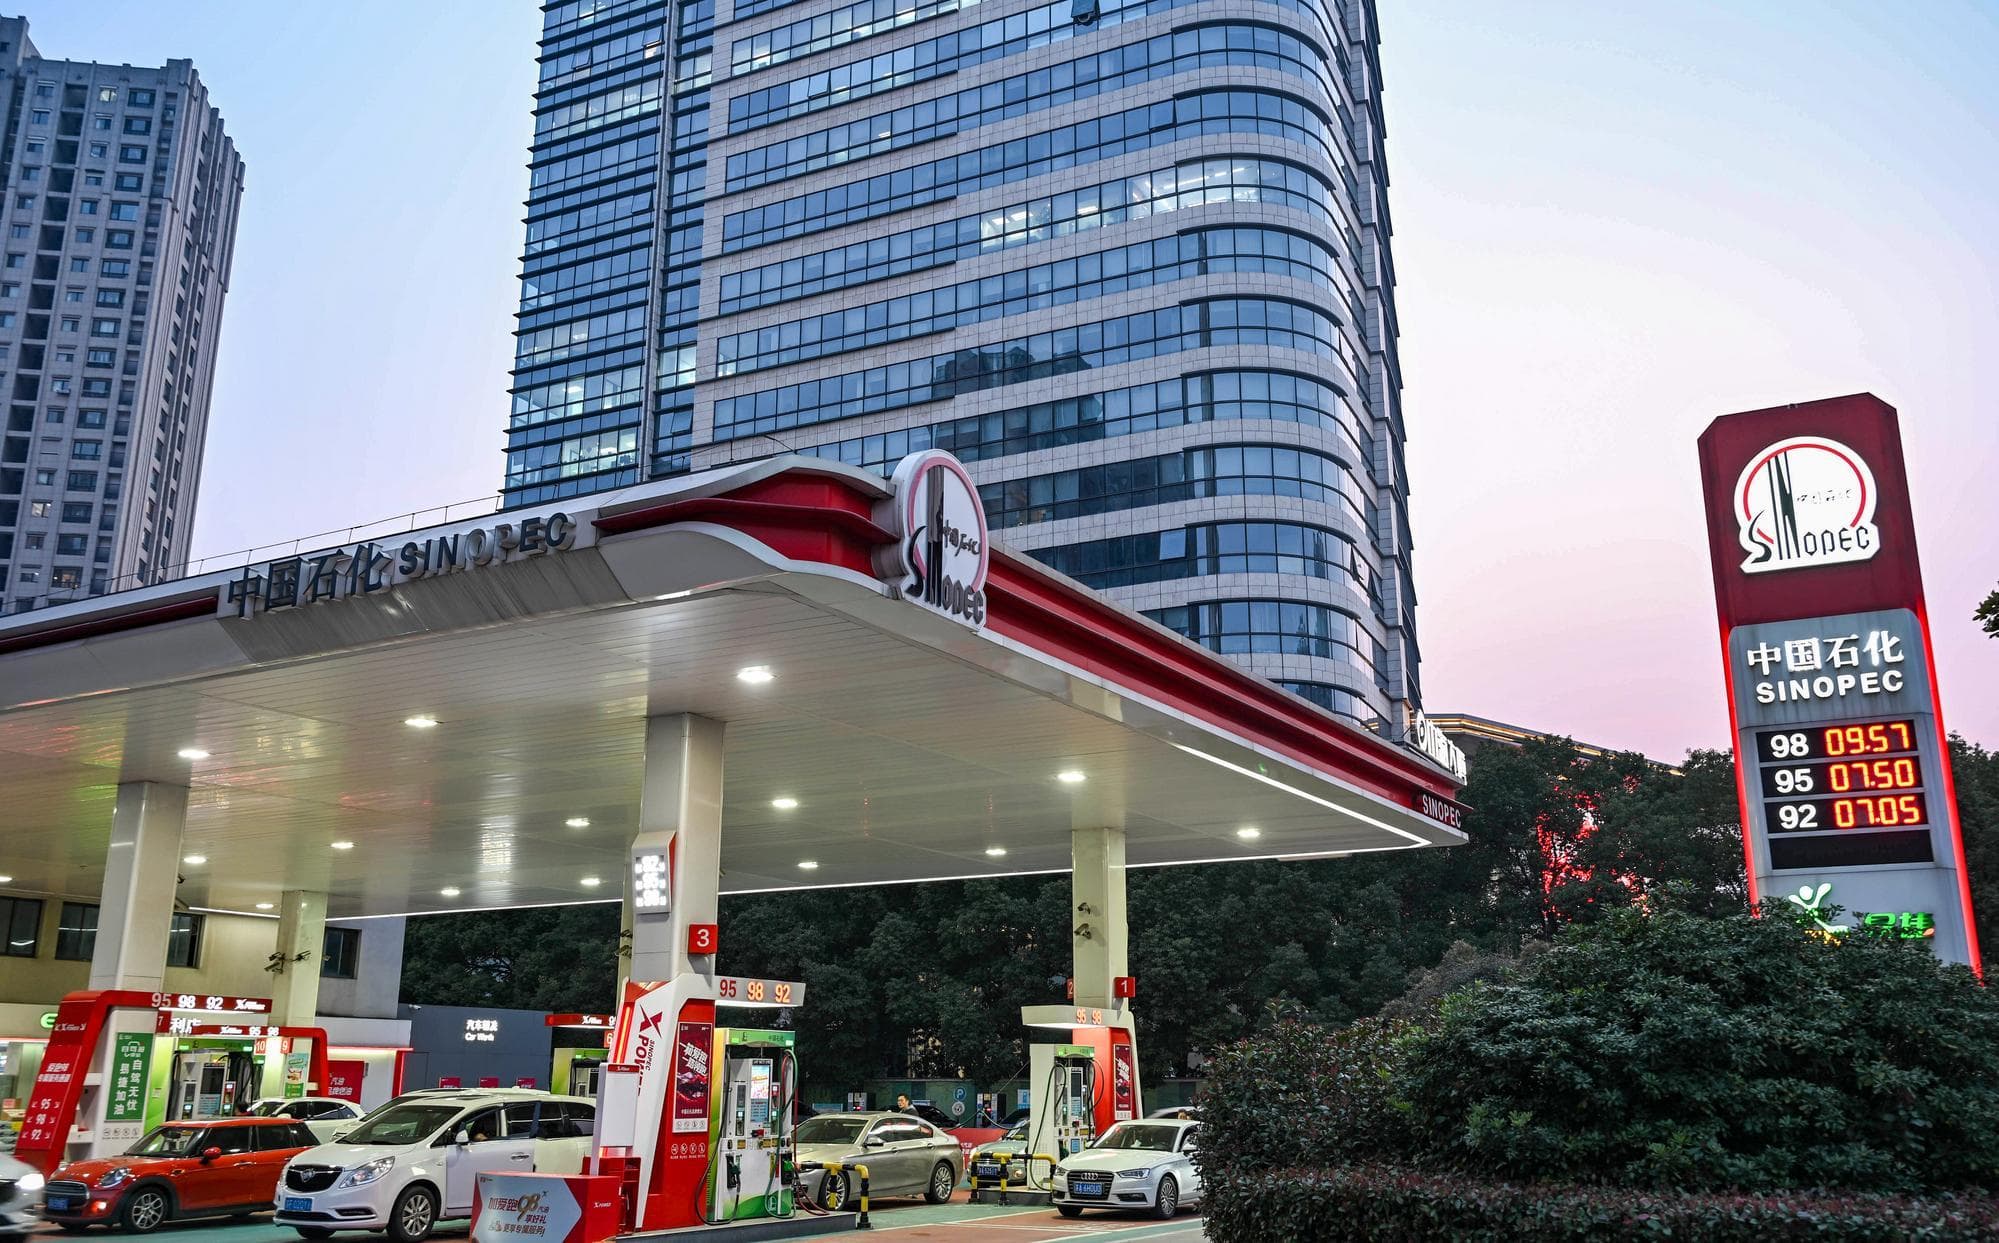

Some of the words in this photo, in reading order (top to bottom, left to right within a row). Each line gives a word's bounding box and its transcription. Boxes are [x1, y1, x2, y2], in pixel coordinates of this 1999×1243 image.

[399, 512, 576, 578] SINOPEC
[228, 542, 392, 619] 中国石化
[1747, 631, 1905, 675] 中国石化
[1756, 670, 1903, 703] SINOPEC
[1770, 733, 1809, 758] 98
[1825, 723, 1909, 755] 09.57
[1774, 768, 1813, 793] 95
[1830, 760, 1914, 791] 07.50
[1423, 794, 1461, 828] SINOPEC
[1779, 804, 1818, 829] 92
[1835, 796, 1920, 827] 07.05
[697, 929, 710, 947] 3
[720, 979, 736, 998] 95
[748, 982, 763, 1000] 98
[774, 985, 790, 1003] 92
[1121, 980, 1127, 993] 1
[152, 993, 171, 1007] 95
[178, 995, 195, 1009] 98
[206, 997, 223, 1010] 92
[158, 1016, 163, 1026] 7
[1077, 1008, 1086, 1024] 95
[1092, 1010, 1102, 1024] 98
[256, 1040, 265, 1051] 10
[282, 1041, 288, 1051] 9
[607, 1033, 613, 1044] 6
[645, 1039, 655, 1071] SINOPEC
[957, 1089, 964, 1098] P
[41, 1099, 52, 1109] 95
[35, 1114, 46, 1124] 98
[31, 1129, 42, 1140] 92
